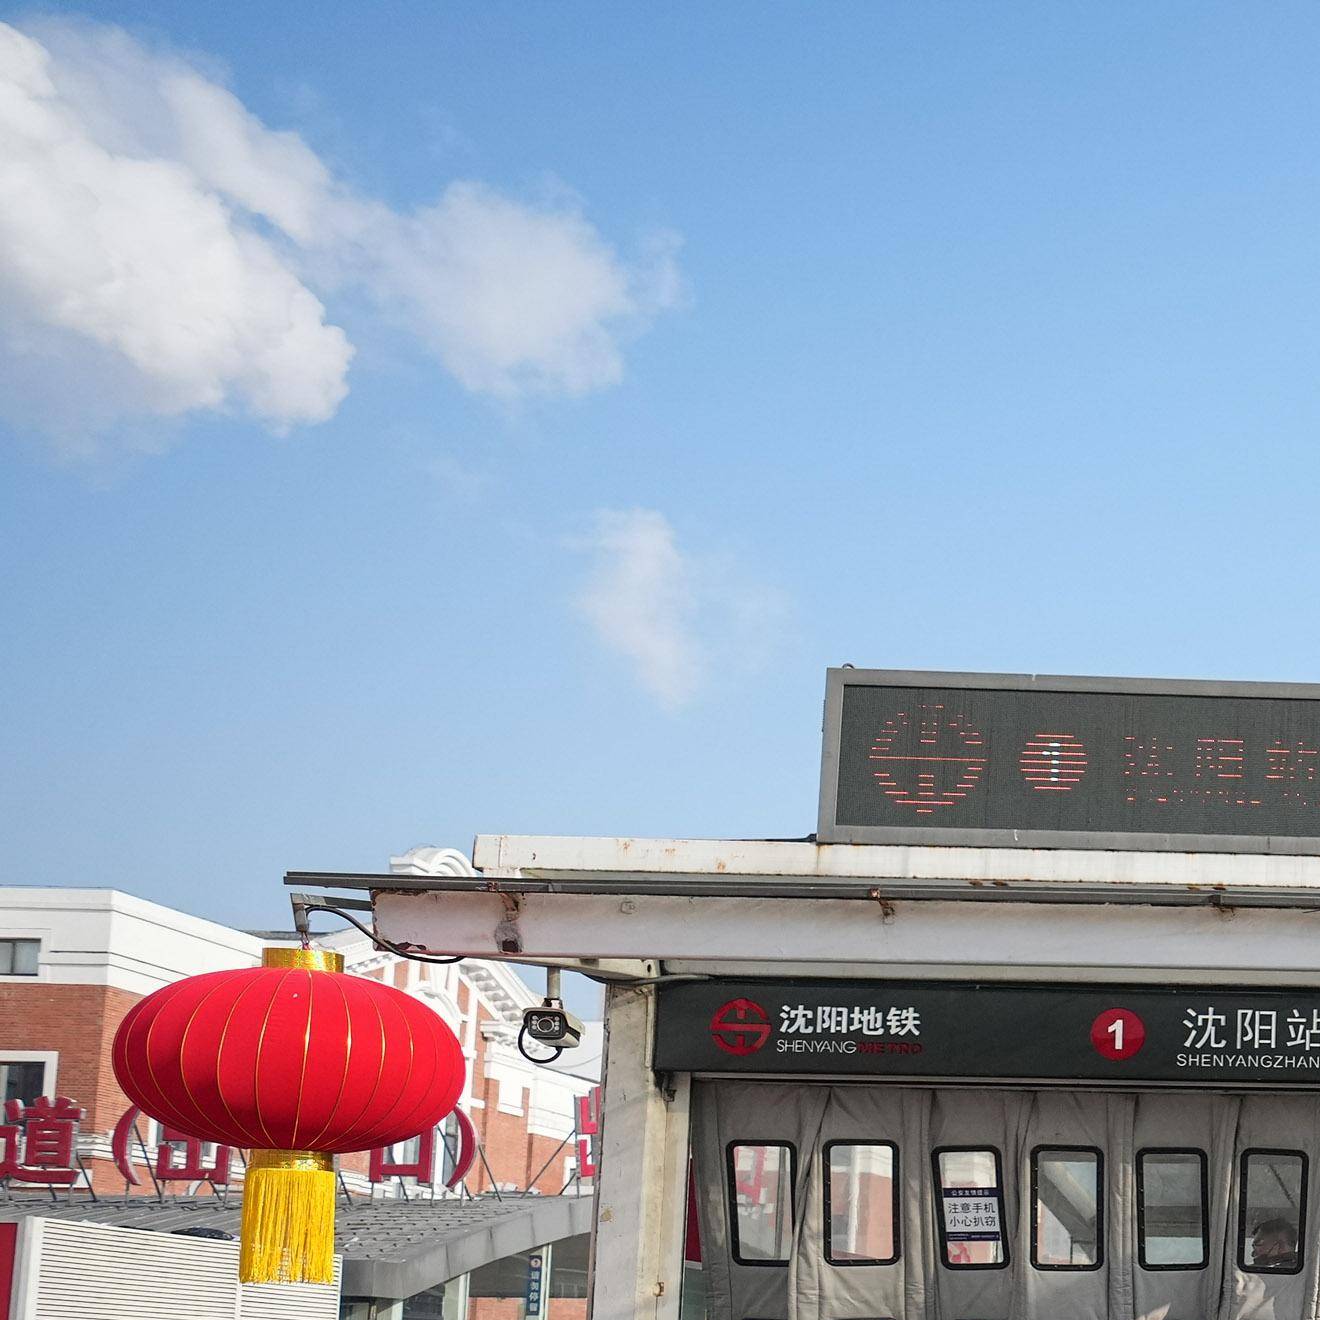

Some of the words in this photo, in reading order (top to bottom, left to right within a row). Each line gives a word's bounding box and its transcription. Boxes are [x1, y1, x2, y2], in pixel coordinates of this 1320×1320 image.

[779, 1004, 922, 1037] 沈阳地铁
[1107, 1018, 1125, 1051] 1
[776, 1038, 858, 1055] SHENYANG
[1176, 1053, 1320, 1070] SHENYANGZHAN
[948, 1201, 997, 1214] 注意手机
[949, 1215, 997, 1228] 小心扒窃
